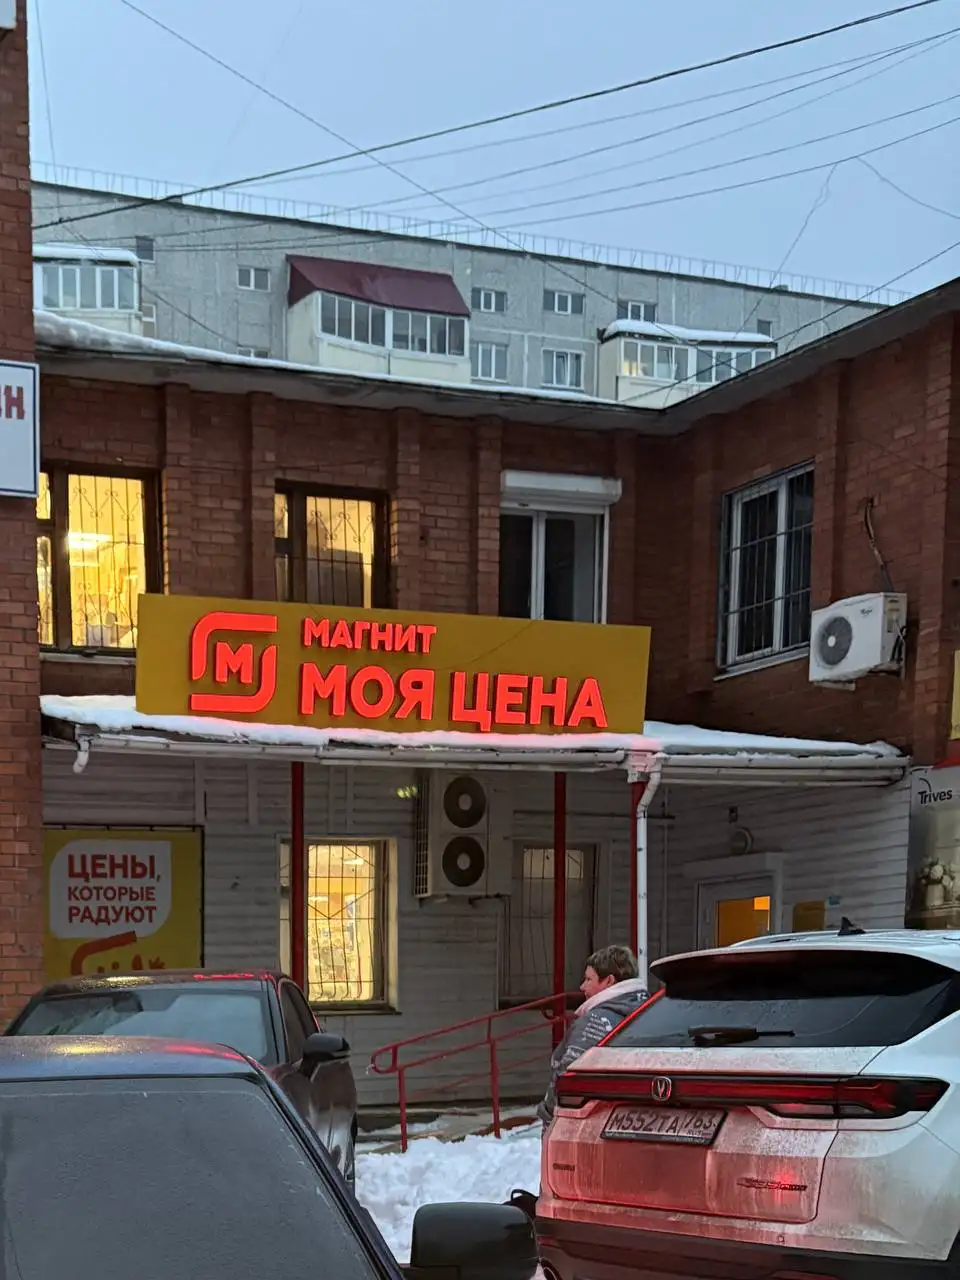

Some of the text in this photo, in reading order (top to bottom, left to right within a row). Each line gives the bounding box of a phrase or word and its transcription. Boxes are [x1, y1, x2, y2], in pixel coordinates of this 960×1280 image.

[303, 617, 437, 654] МАГНИТ
[301, 663, 608, 732] МОЯ ЦЕНА
[918, 790, 953, 805] Trives
[68, 854, 161, 882] ЦЕНЫ,
[68, 886, 157, 901] КОТОРЫЕ
[68, 905, 157, 925] РАДУЮТ
